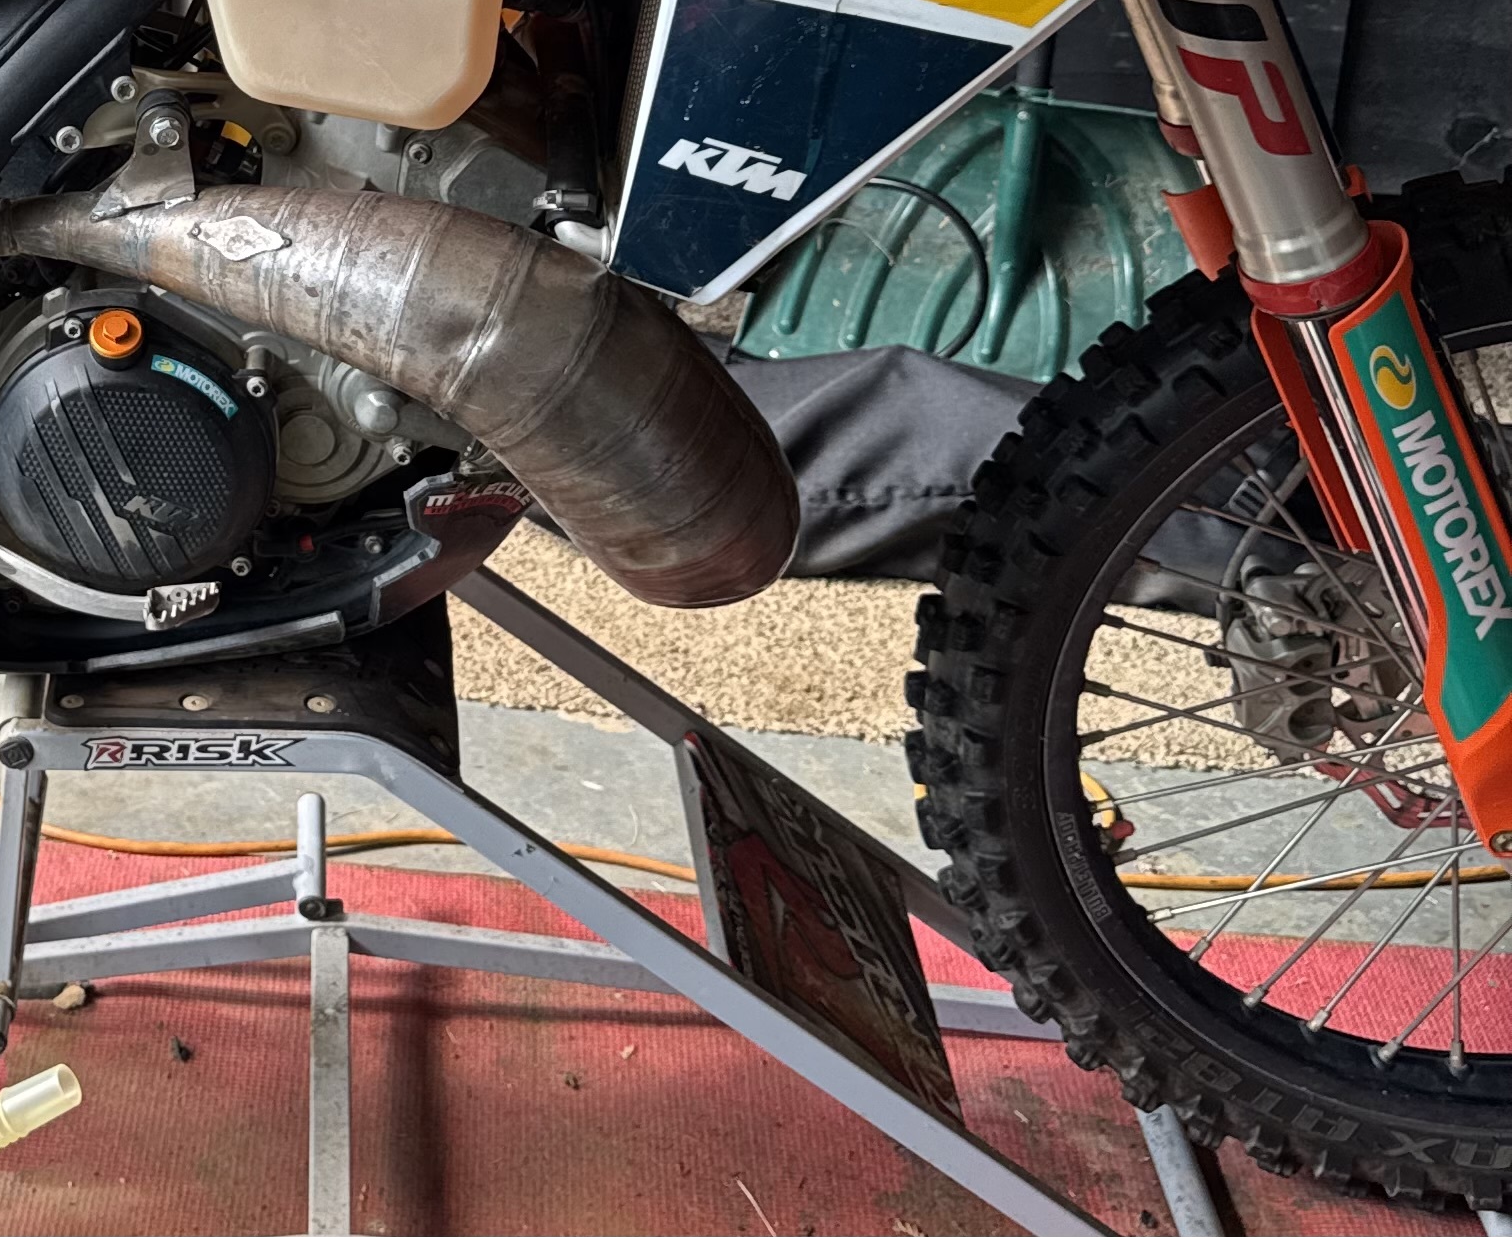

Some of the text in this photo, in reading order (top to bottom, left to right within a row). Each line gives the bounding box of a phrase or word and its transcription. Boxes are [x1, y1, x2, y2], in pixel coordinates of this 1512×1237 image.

[658, 137, 807, 201] KTM
[174, 362, 239, 418] MOTOREX
[424, 479, 534, 512] MLECULE
[1392, 410, 1512, 641] MOTOREX
[128, 734, 290, 766] RISK
